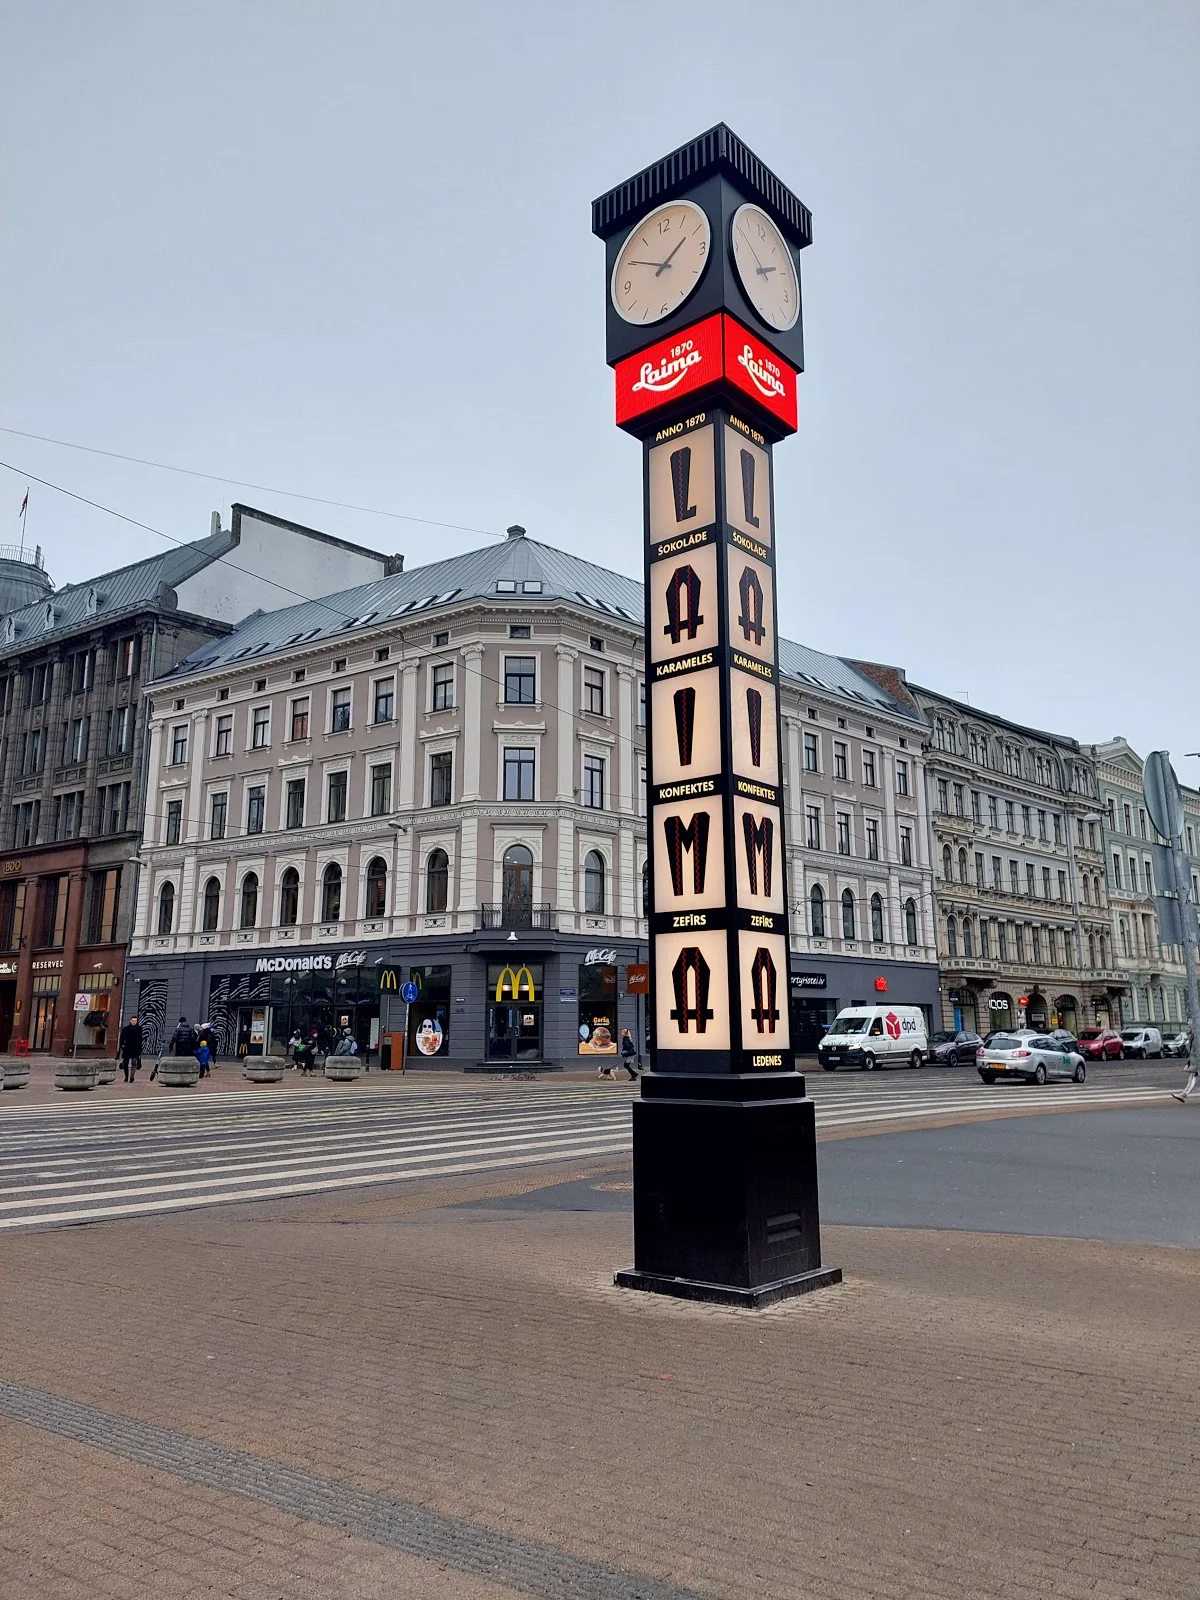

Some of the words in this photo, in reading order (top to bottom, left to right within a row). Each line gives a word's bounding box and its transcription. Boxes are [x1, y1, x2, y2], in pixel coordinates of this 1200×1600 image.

[657, 218, 670, 235] 12
[757, 223, 766, 242] 12
[698, 241, 706, 256] 3
[624, 280, 632, 295] 9
[783, 289, 789, 303] 3
[670, 339, 693, 359] 1870
[631, 350, 702, 392] Laima
[737, 344, 786, 397] Laima
[764, 358, 780, 379] 1870
[655, 422, 683, 442] ANNO
[685, 412, 706, 429] 1870
[729, 414, 750, 435] ANNO
[750, 429, 765, 445] 1870
[656, 652, 713, 677] KARAMELES
[733, 653, 772, 678] KARAMELES
[659, 780, 714, 799] KONFEKTES
[737, 780, 776, 801] KONFEKTES
[672, 913, 707, 928] ZEFĪRS
[750, 914, 774, 929] ZEFĪRS
[31, 960, 64, 970] RESERVED
[255, 955, 332, 972] McDonald's
[988, 999, 1009, 1010] IQOS
[901, 1017, 916, 1033] dpd
[752, 1055, 782, 1067] LEDENES
